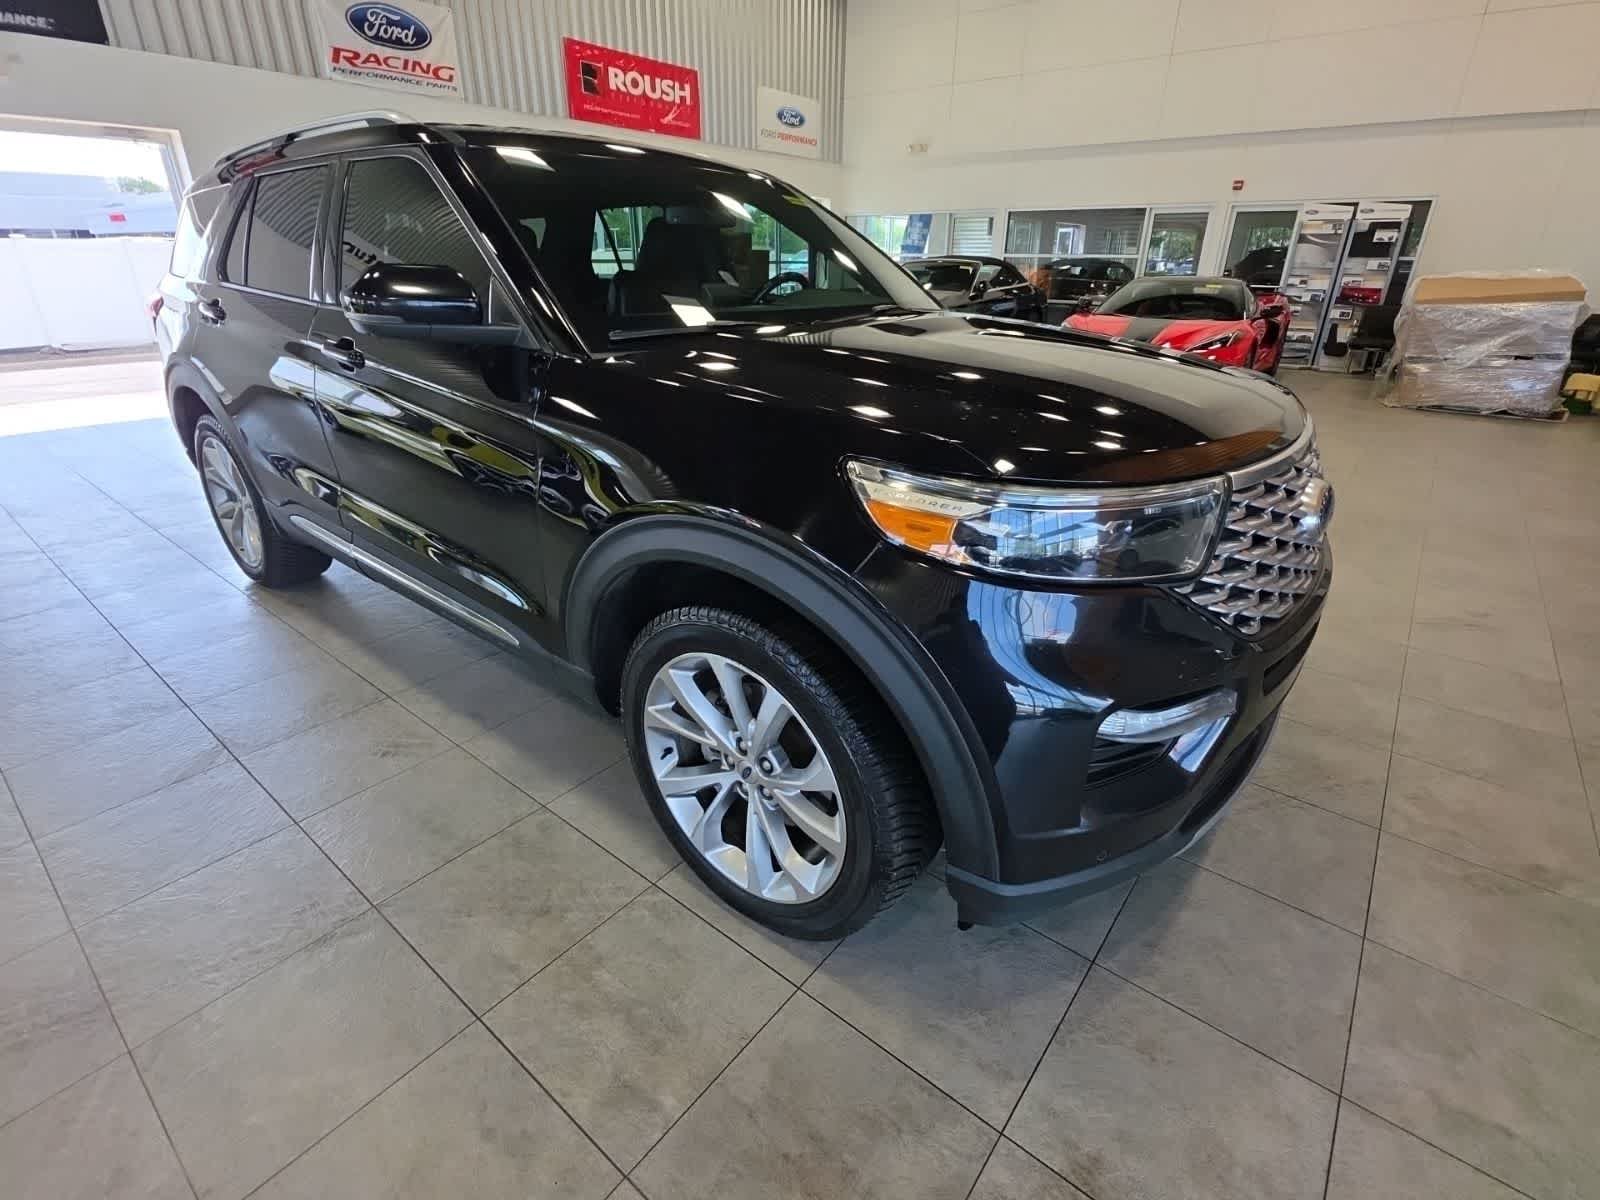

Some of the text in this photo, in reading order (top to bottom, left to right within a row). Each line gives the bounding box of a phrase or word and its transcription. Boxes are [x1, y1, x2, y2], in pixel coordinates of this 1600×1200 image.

[364, 8, 416, 44] Ford
[330, 46, 455, 82] RACING
[332, 66, 457, 92] PERFORMANCE PARTS
[608, 66, 691, 105] ROUSH
